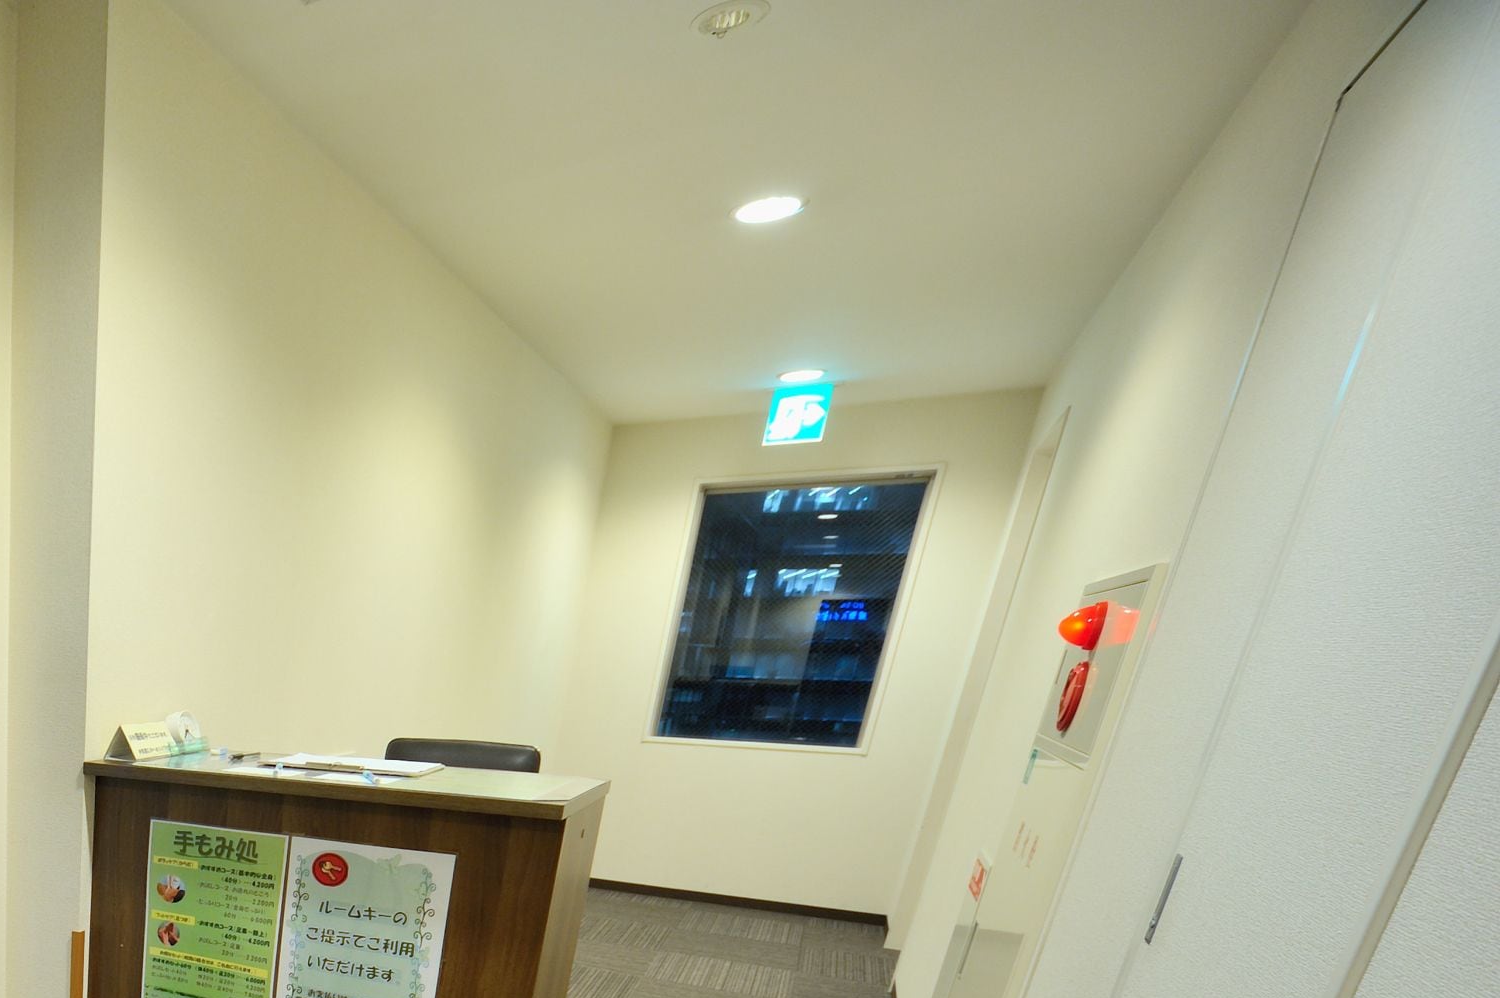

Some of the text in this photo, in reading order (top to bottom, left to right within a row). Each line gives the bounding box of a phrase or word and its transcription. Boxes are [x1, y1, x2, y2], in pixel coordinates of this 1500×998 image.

[173, 830, 259, 864] 手もみ処
[318, 900, 408, 926] ルームキーの
